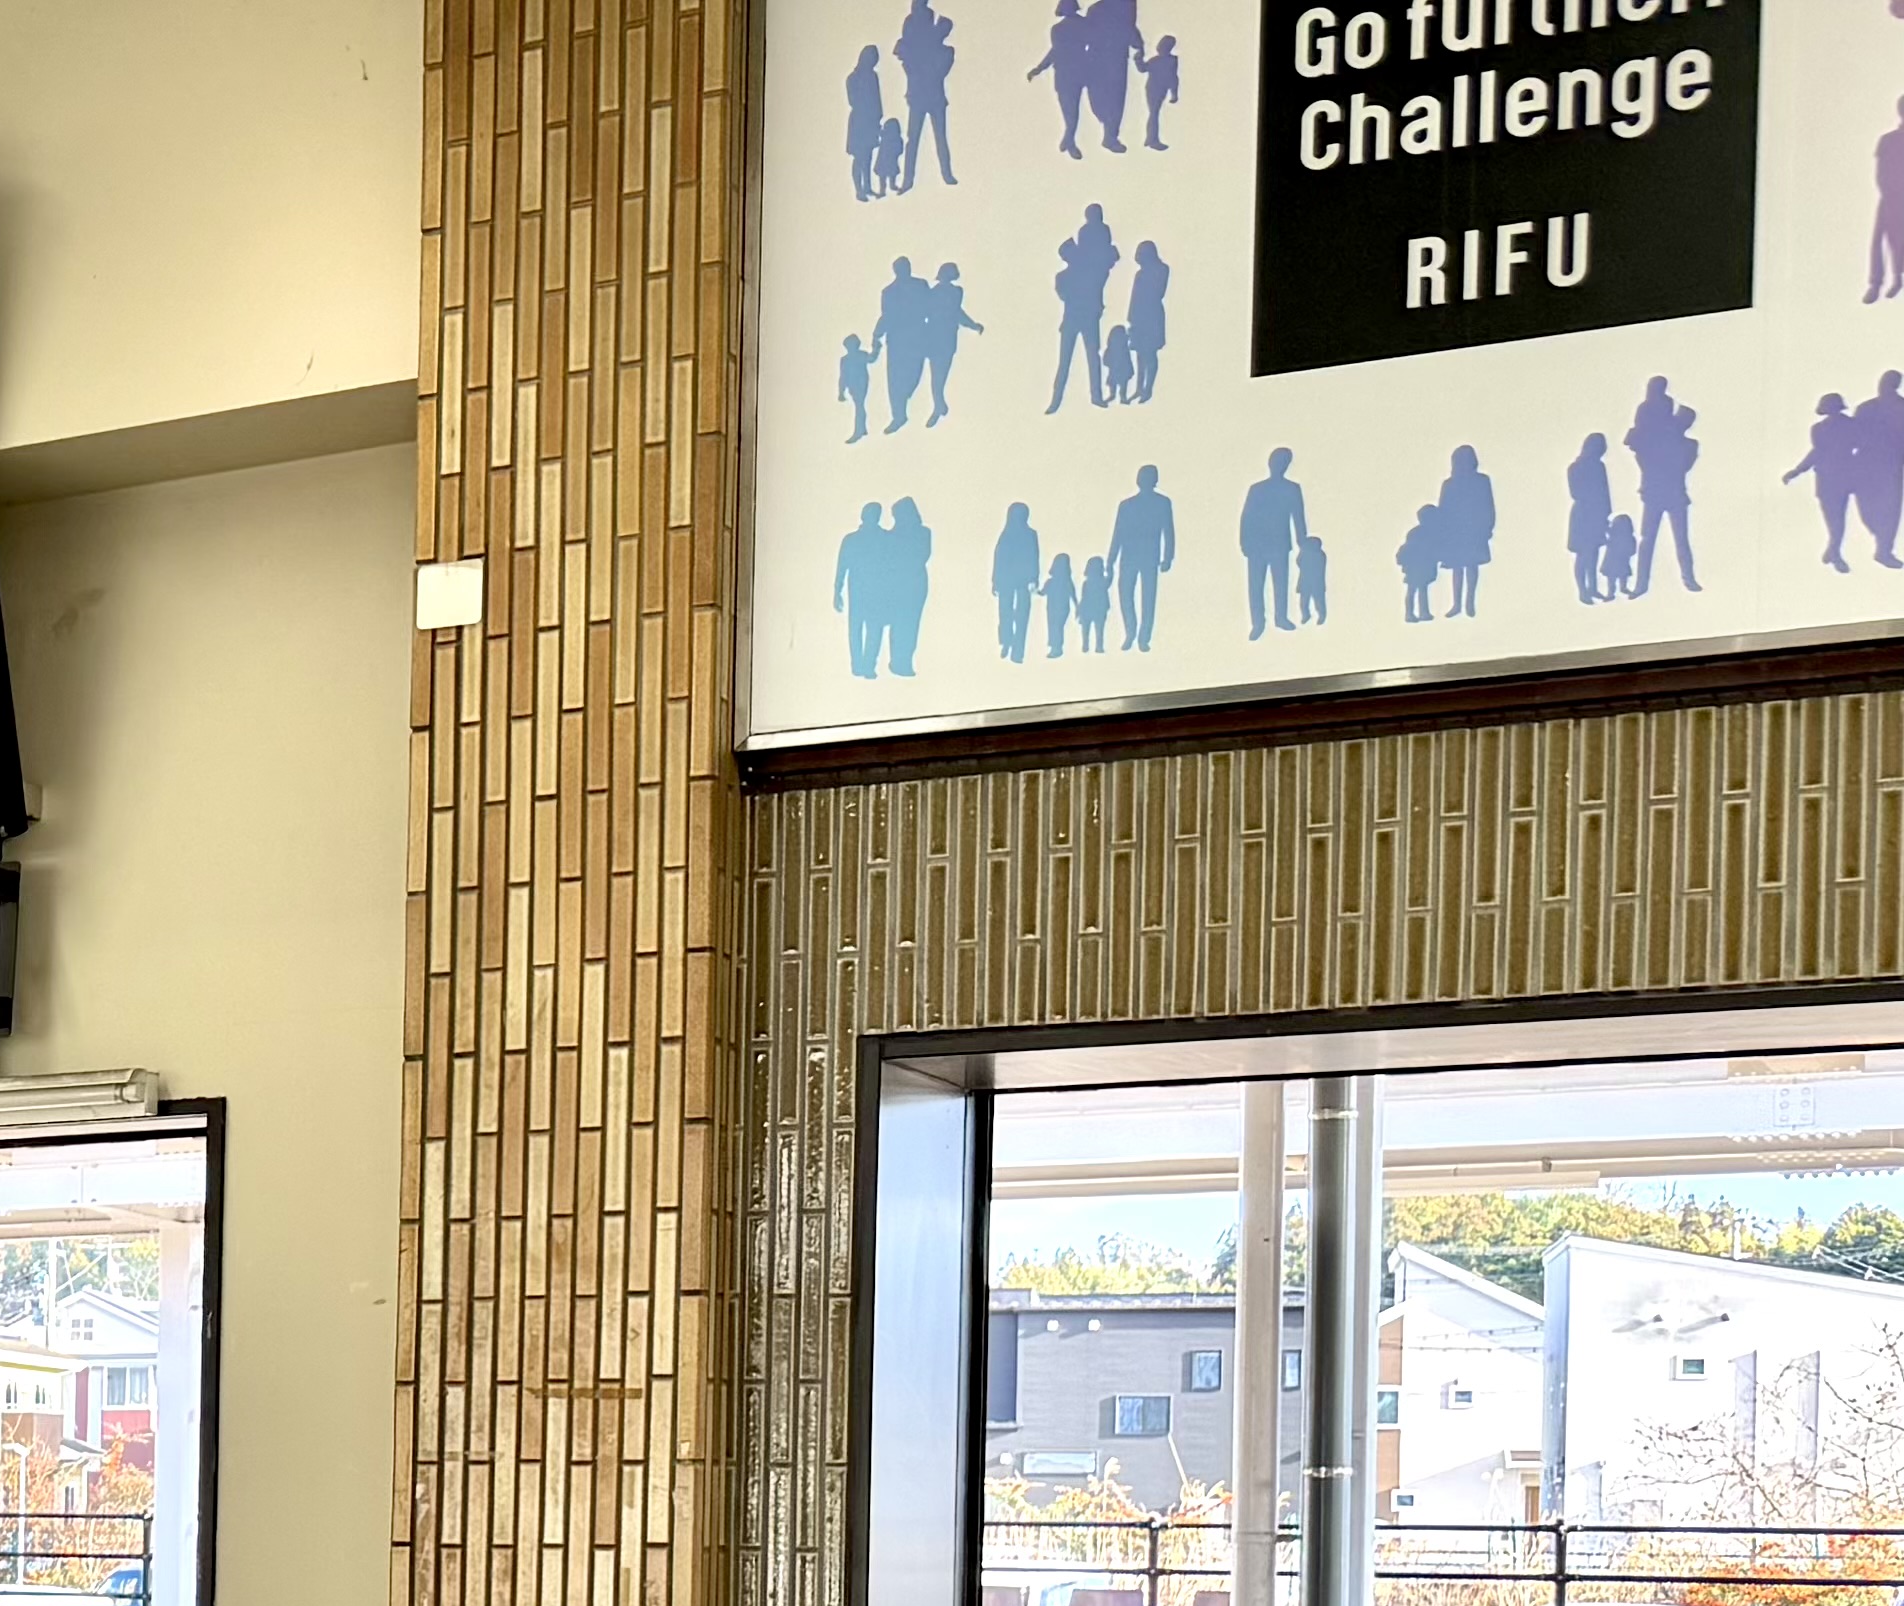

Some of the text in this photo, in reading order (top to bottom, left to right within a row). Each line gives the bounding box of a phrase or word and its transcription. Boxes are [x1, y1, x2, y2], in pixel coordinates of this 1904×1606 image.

[1294, 7, 1388, 79] Go
[1300, 48, 1713, 171] Challenge
[1406, 211, 1590, 309] RIFU
